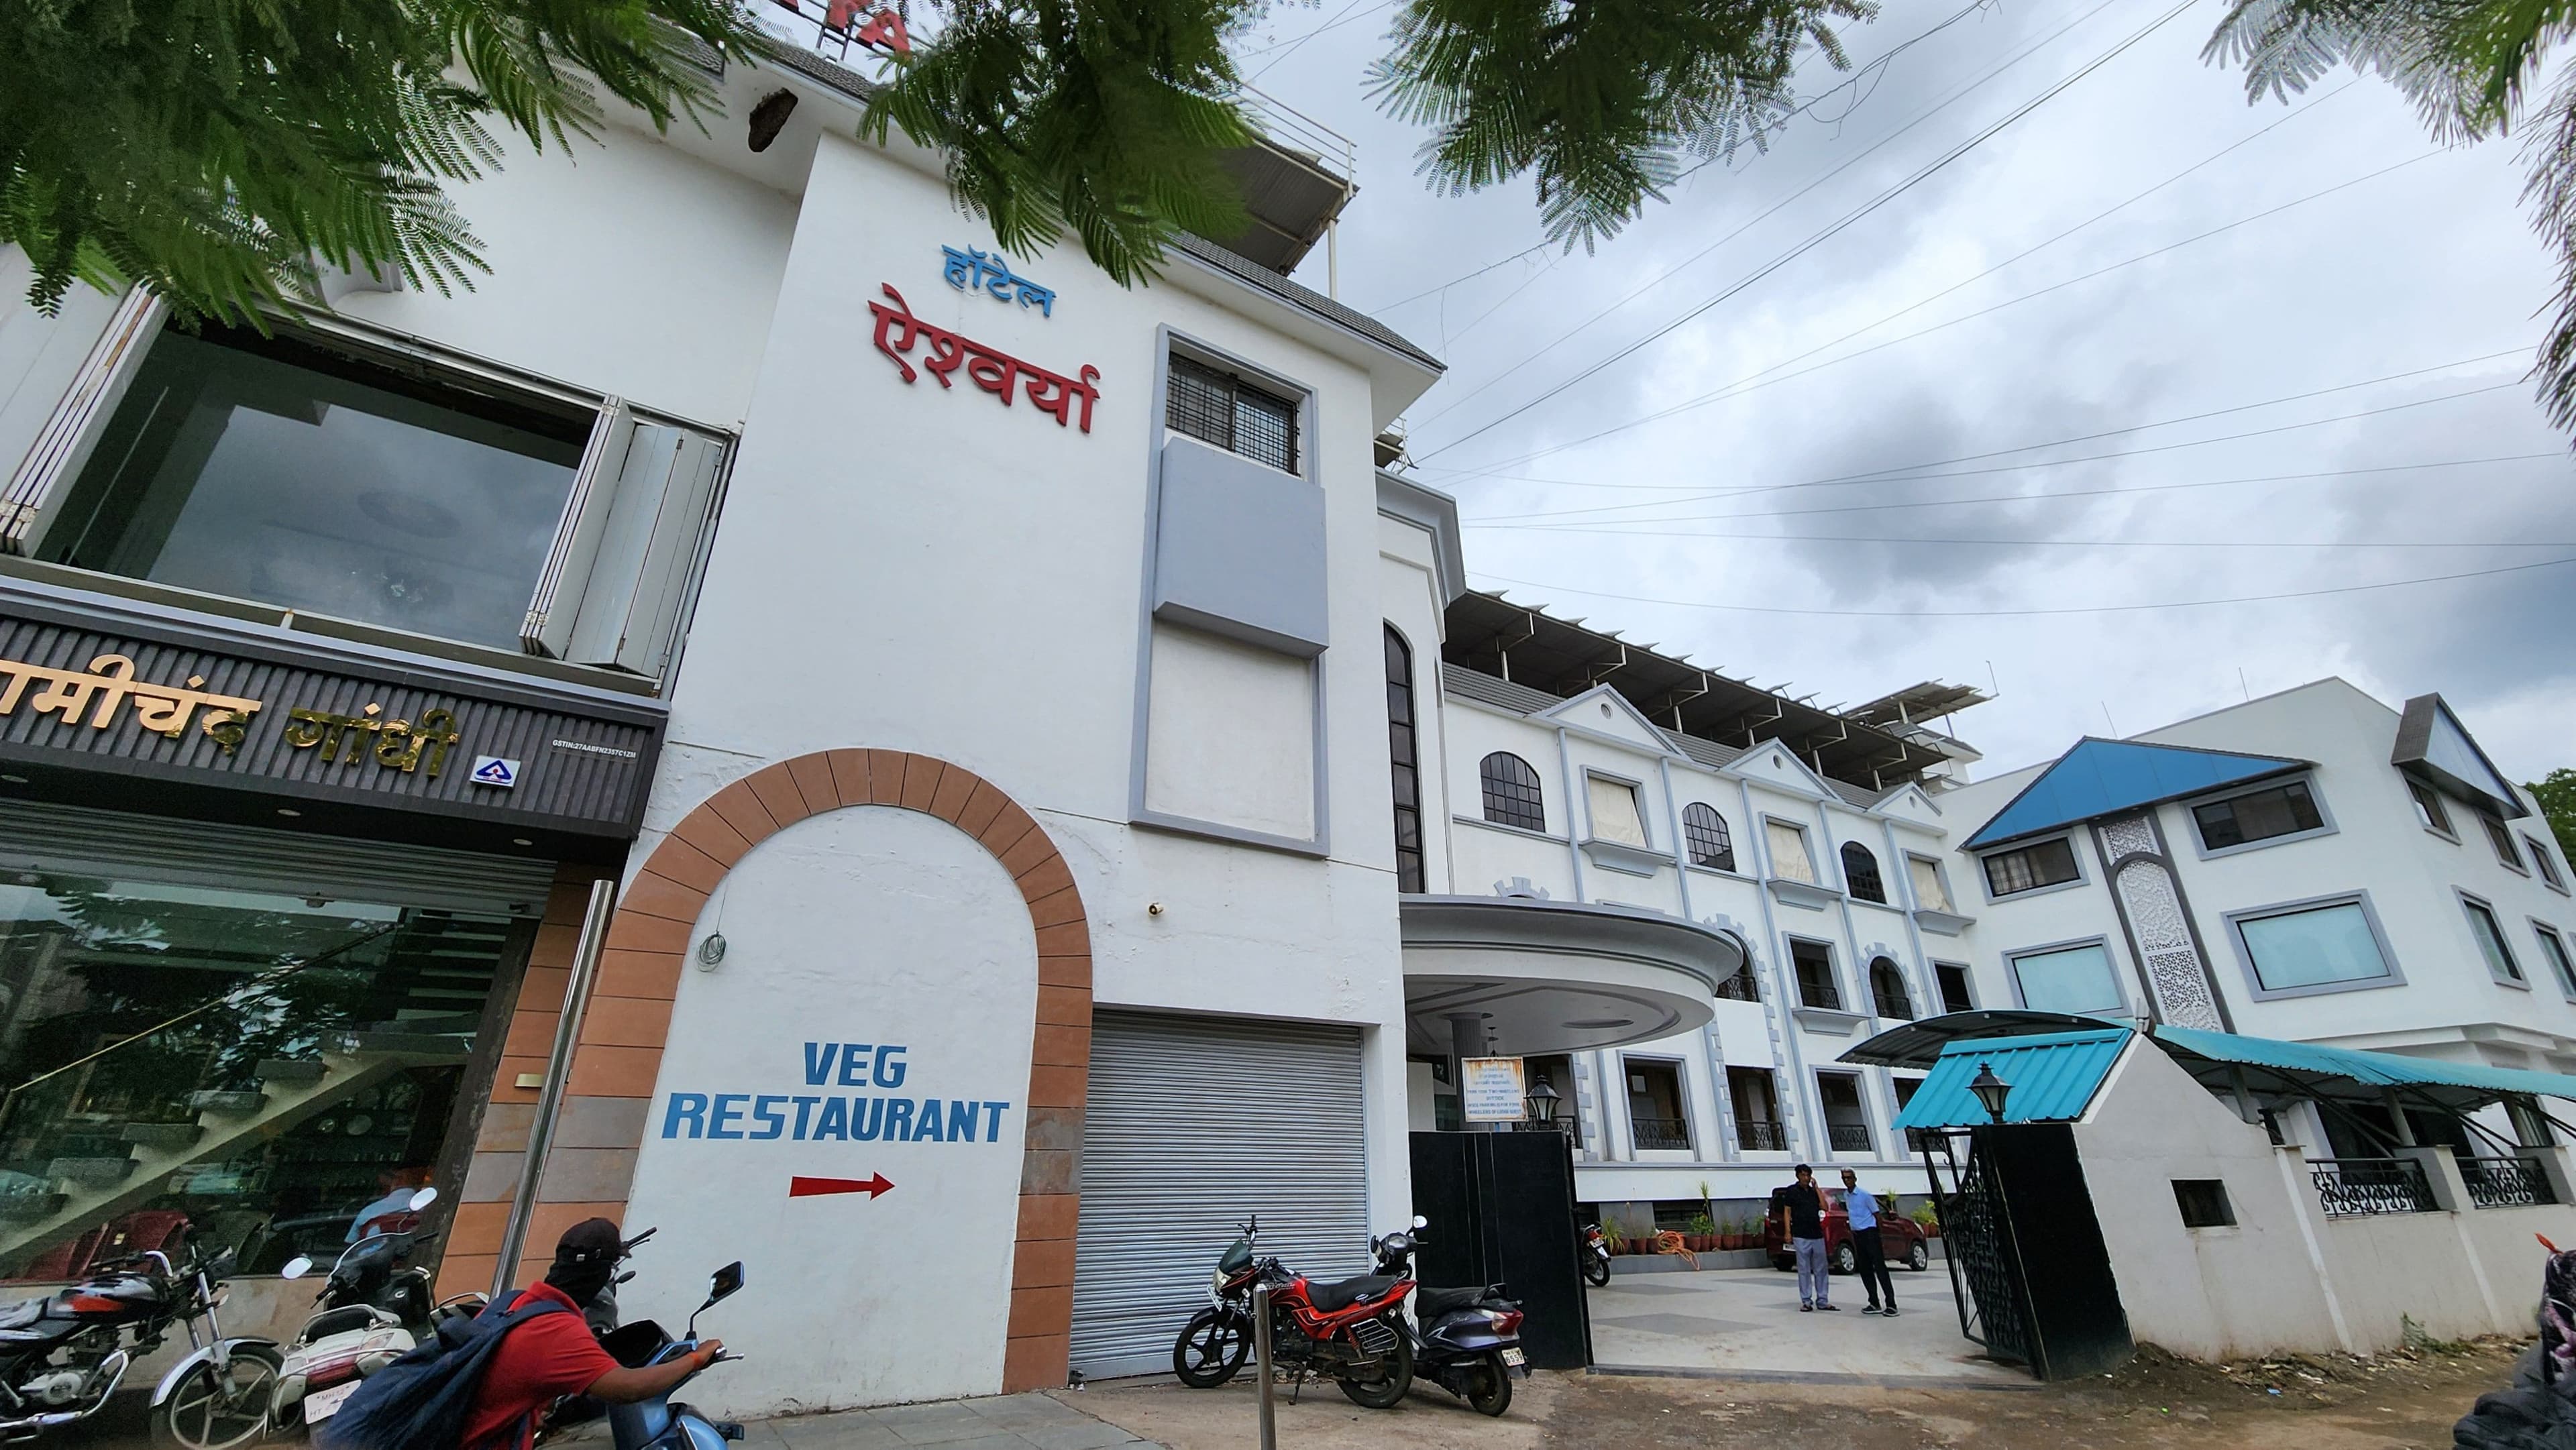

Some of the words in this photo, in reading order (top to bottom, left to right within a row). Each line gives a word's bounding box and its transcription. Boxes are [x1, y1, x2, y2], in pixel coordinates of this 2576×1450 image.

[941, 243, 1057, 317] हॉटेल
[867, 282, 1101, 434] ऐश्वर्या
[285, 702, 459, 777] गांधी
[804, 1042, 908, 1089] VEG
[661, 1092, 1010, 1143] RESTAURANT
